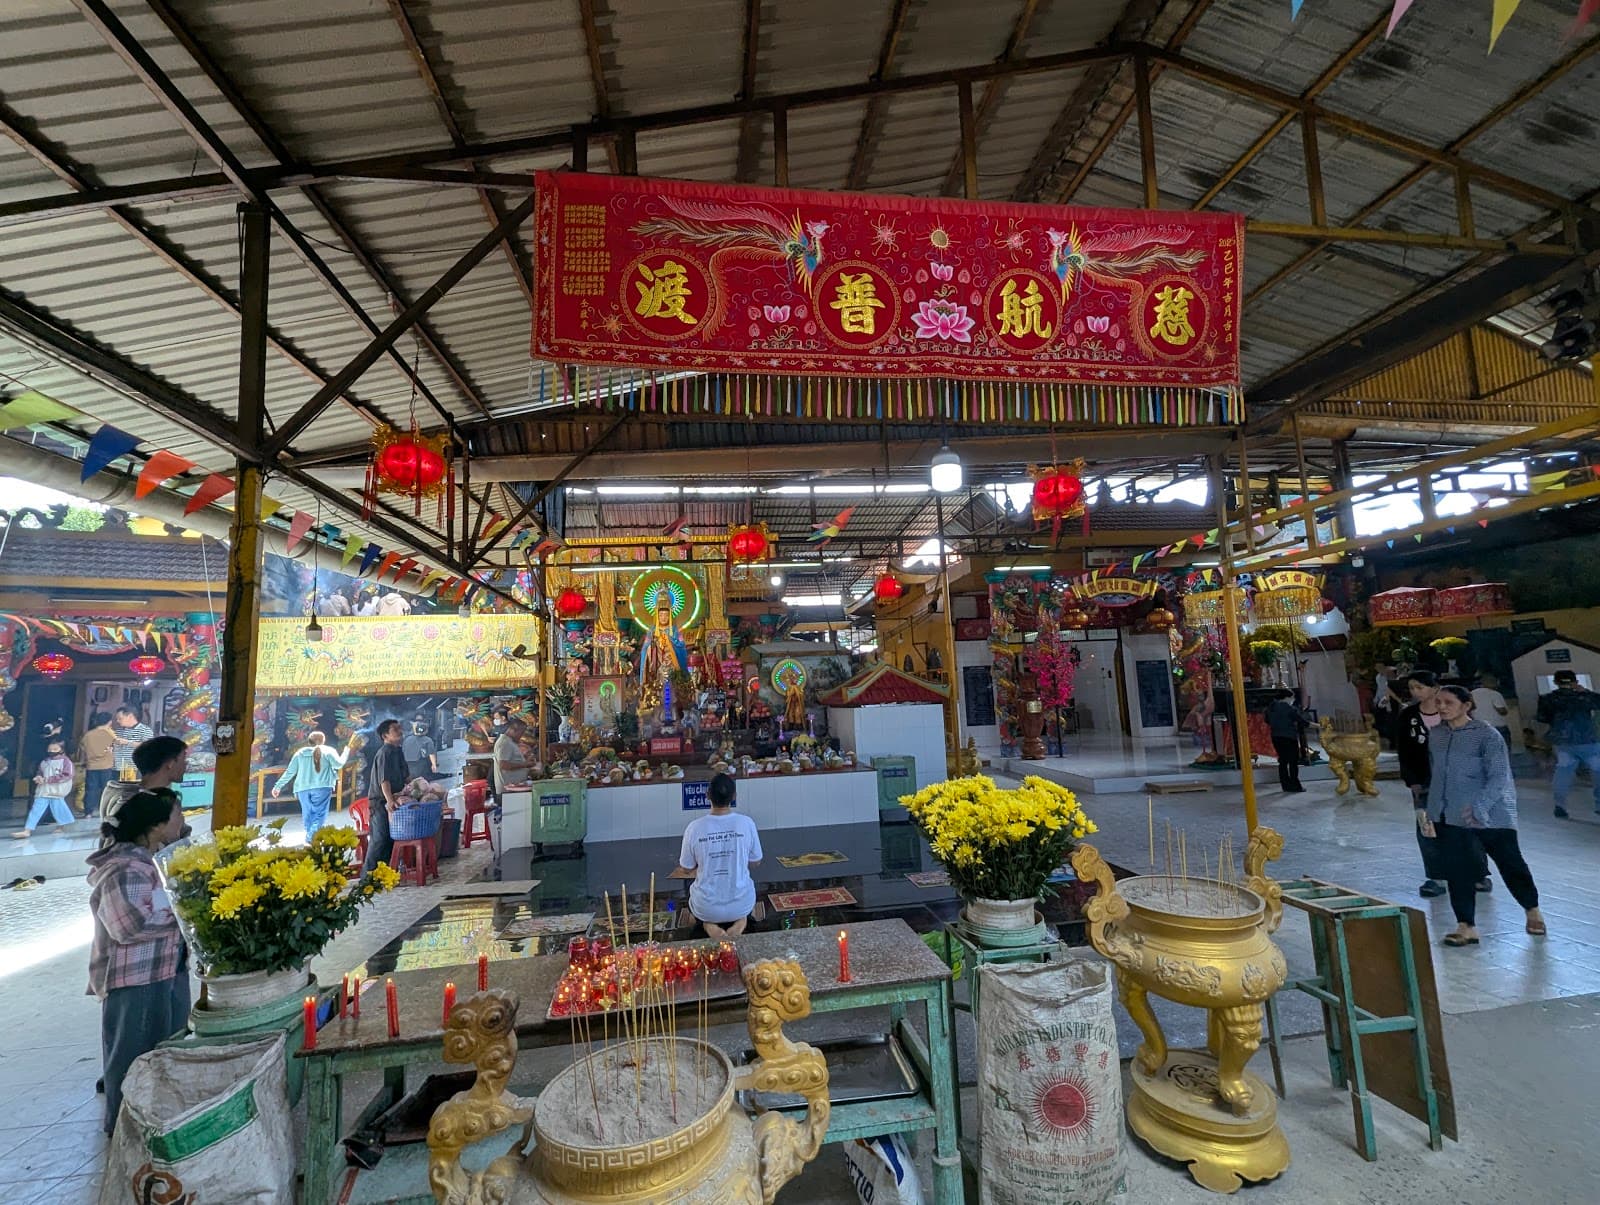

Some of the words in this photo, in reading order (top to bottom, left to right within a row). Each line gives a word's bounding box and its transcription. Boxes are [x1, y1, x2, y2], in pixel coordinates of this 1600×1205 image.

[634, 260, 698, 325] 渡
[829, 272, 886, 335] 普
[996, 278, 1051, 339] 航
[1150, 285, 1196, 346] 慈
[1037, 1021, 1094, 1041] INDUSTRY
